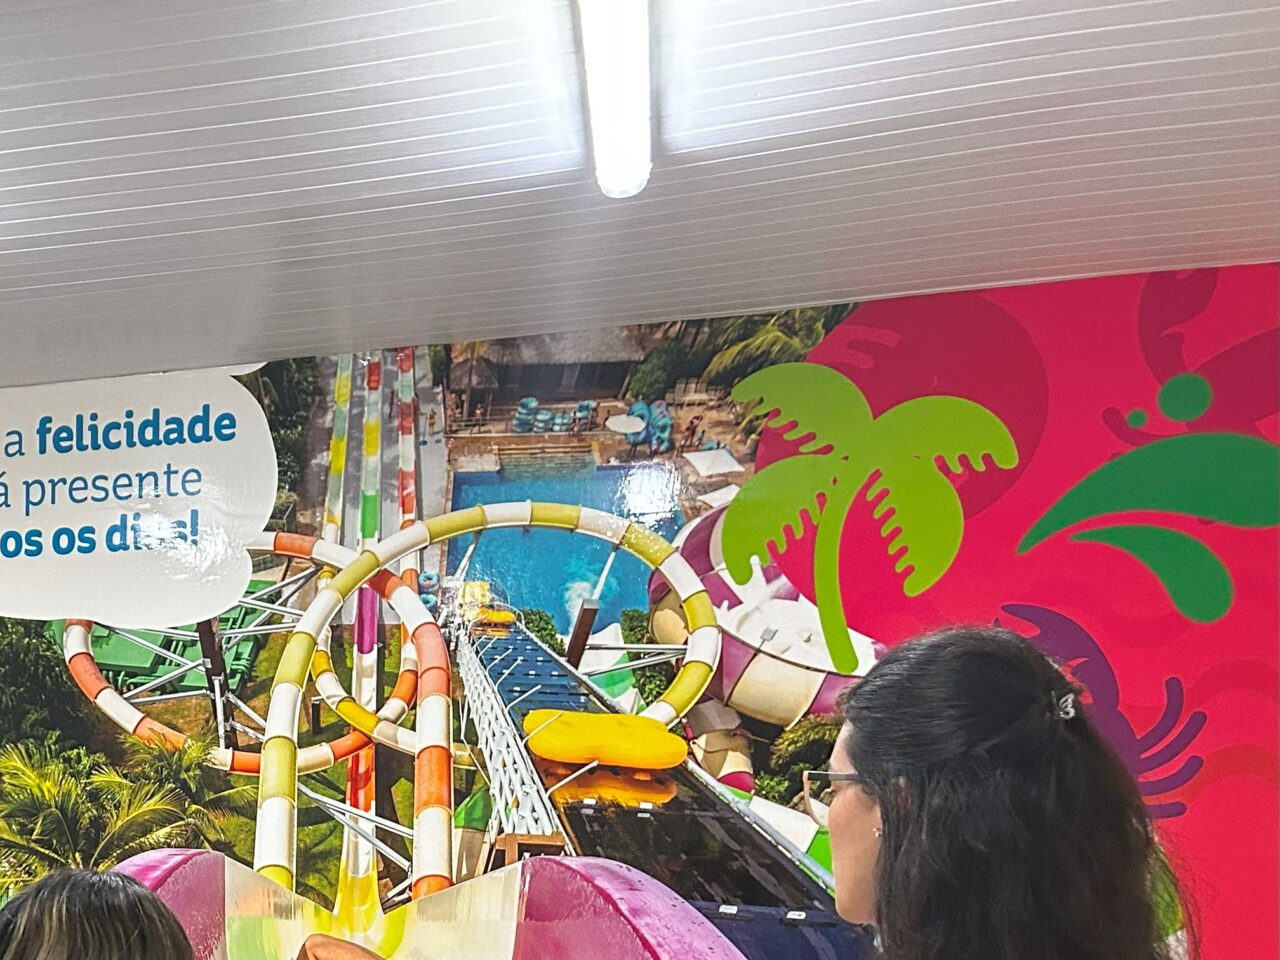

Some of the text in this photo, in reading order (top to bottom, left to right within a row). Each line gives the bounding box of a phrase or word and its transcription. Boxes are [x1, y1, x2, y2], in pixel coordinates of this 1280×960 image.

[4, 430, 25, 458] a
[36, 403, 237, 455] felicidade
[24, 462, 202, 516] presente
[51, 525, 96, 556] os
[105, 509, 199, 552] dis!
